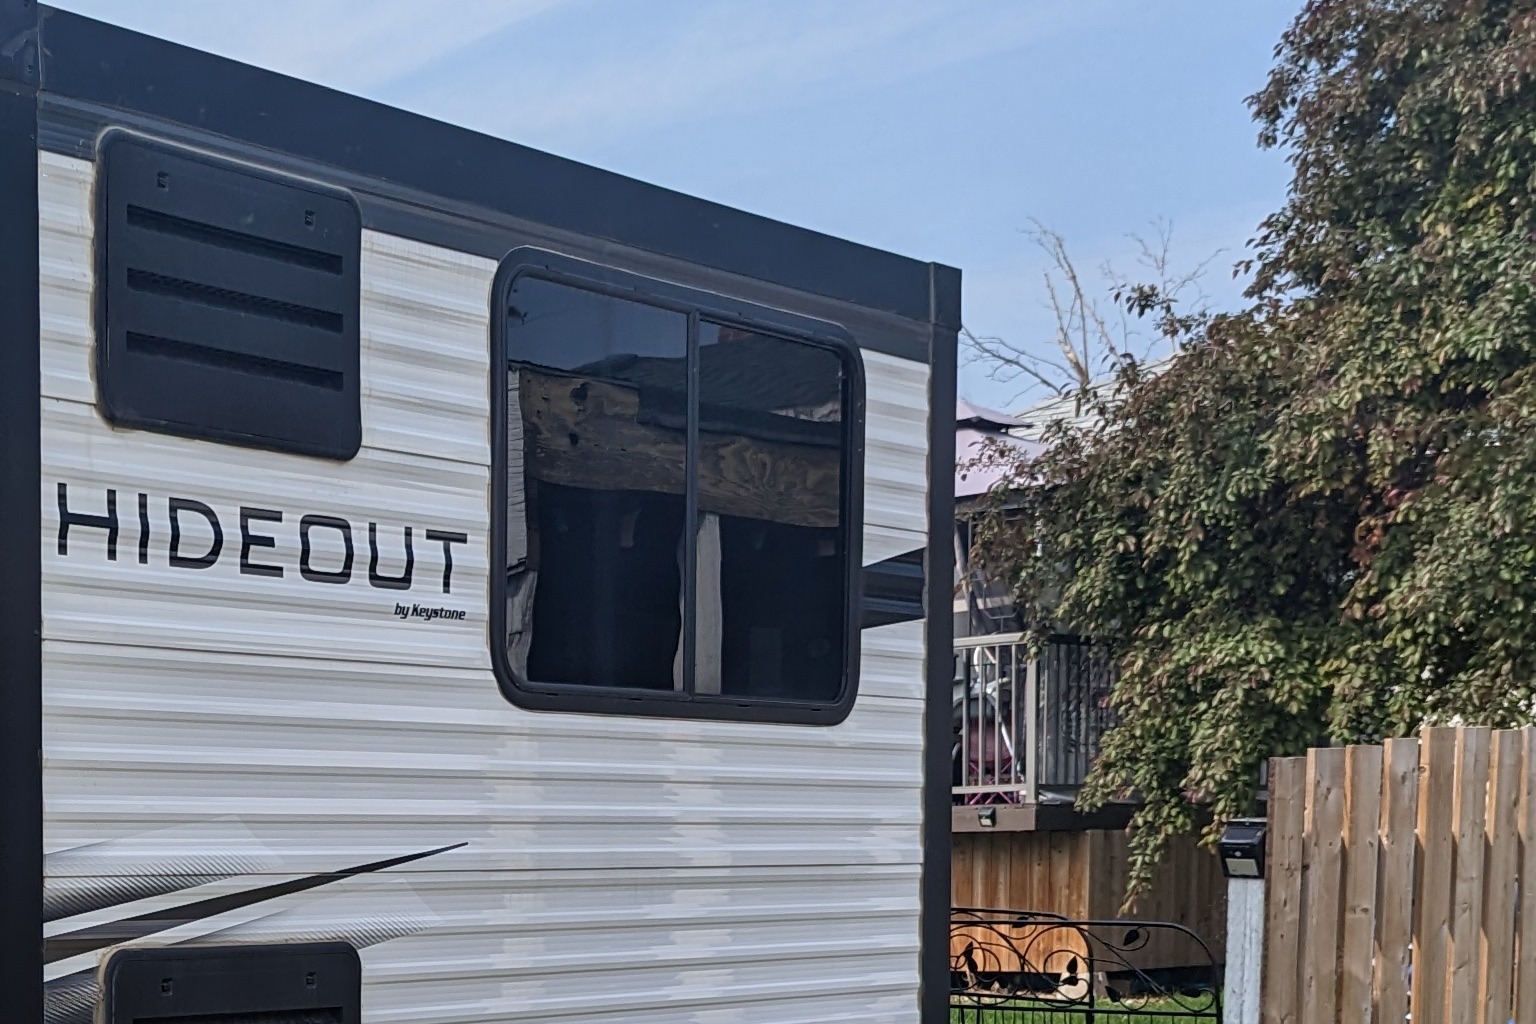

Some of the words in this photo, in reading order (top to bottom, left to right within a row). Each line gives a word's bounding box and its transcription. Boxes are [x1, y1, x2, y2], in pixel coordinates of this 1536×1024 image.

[56, 482, 468, 594] HIDEOUT
[393, 602, 410, 620] by
[411, 603, 466, 621] Keystone
